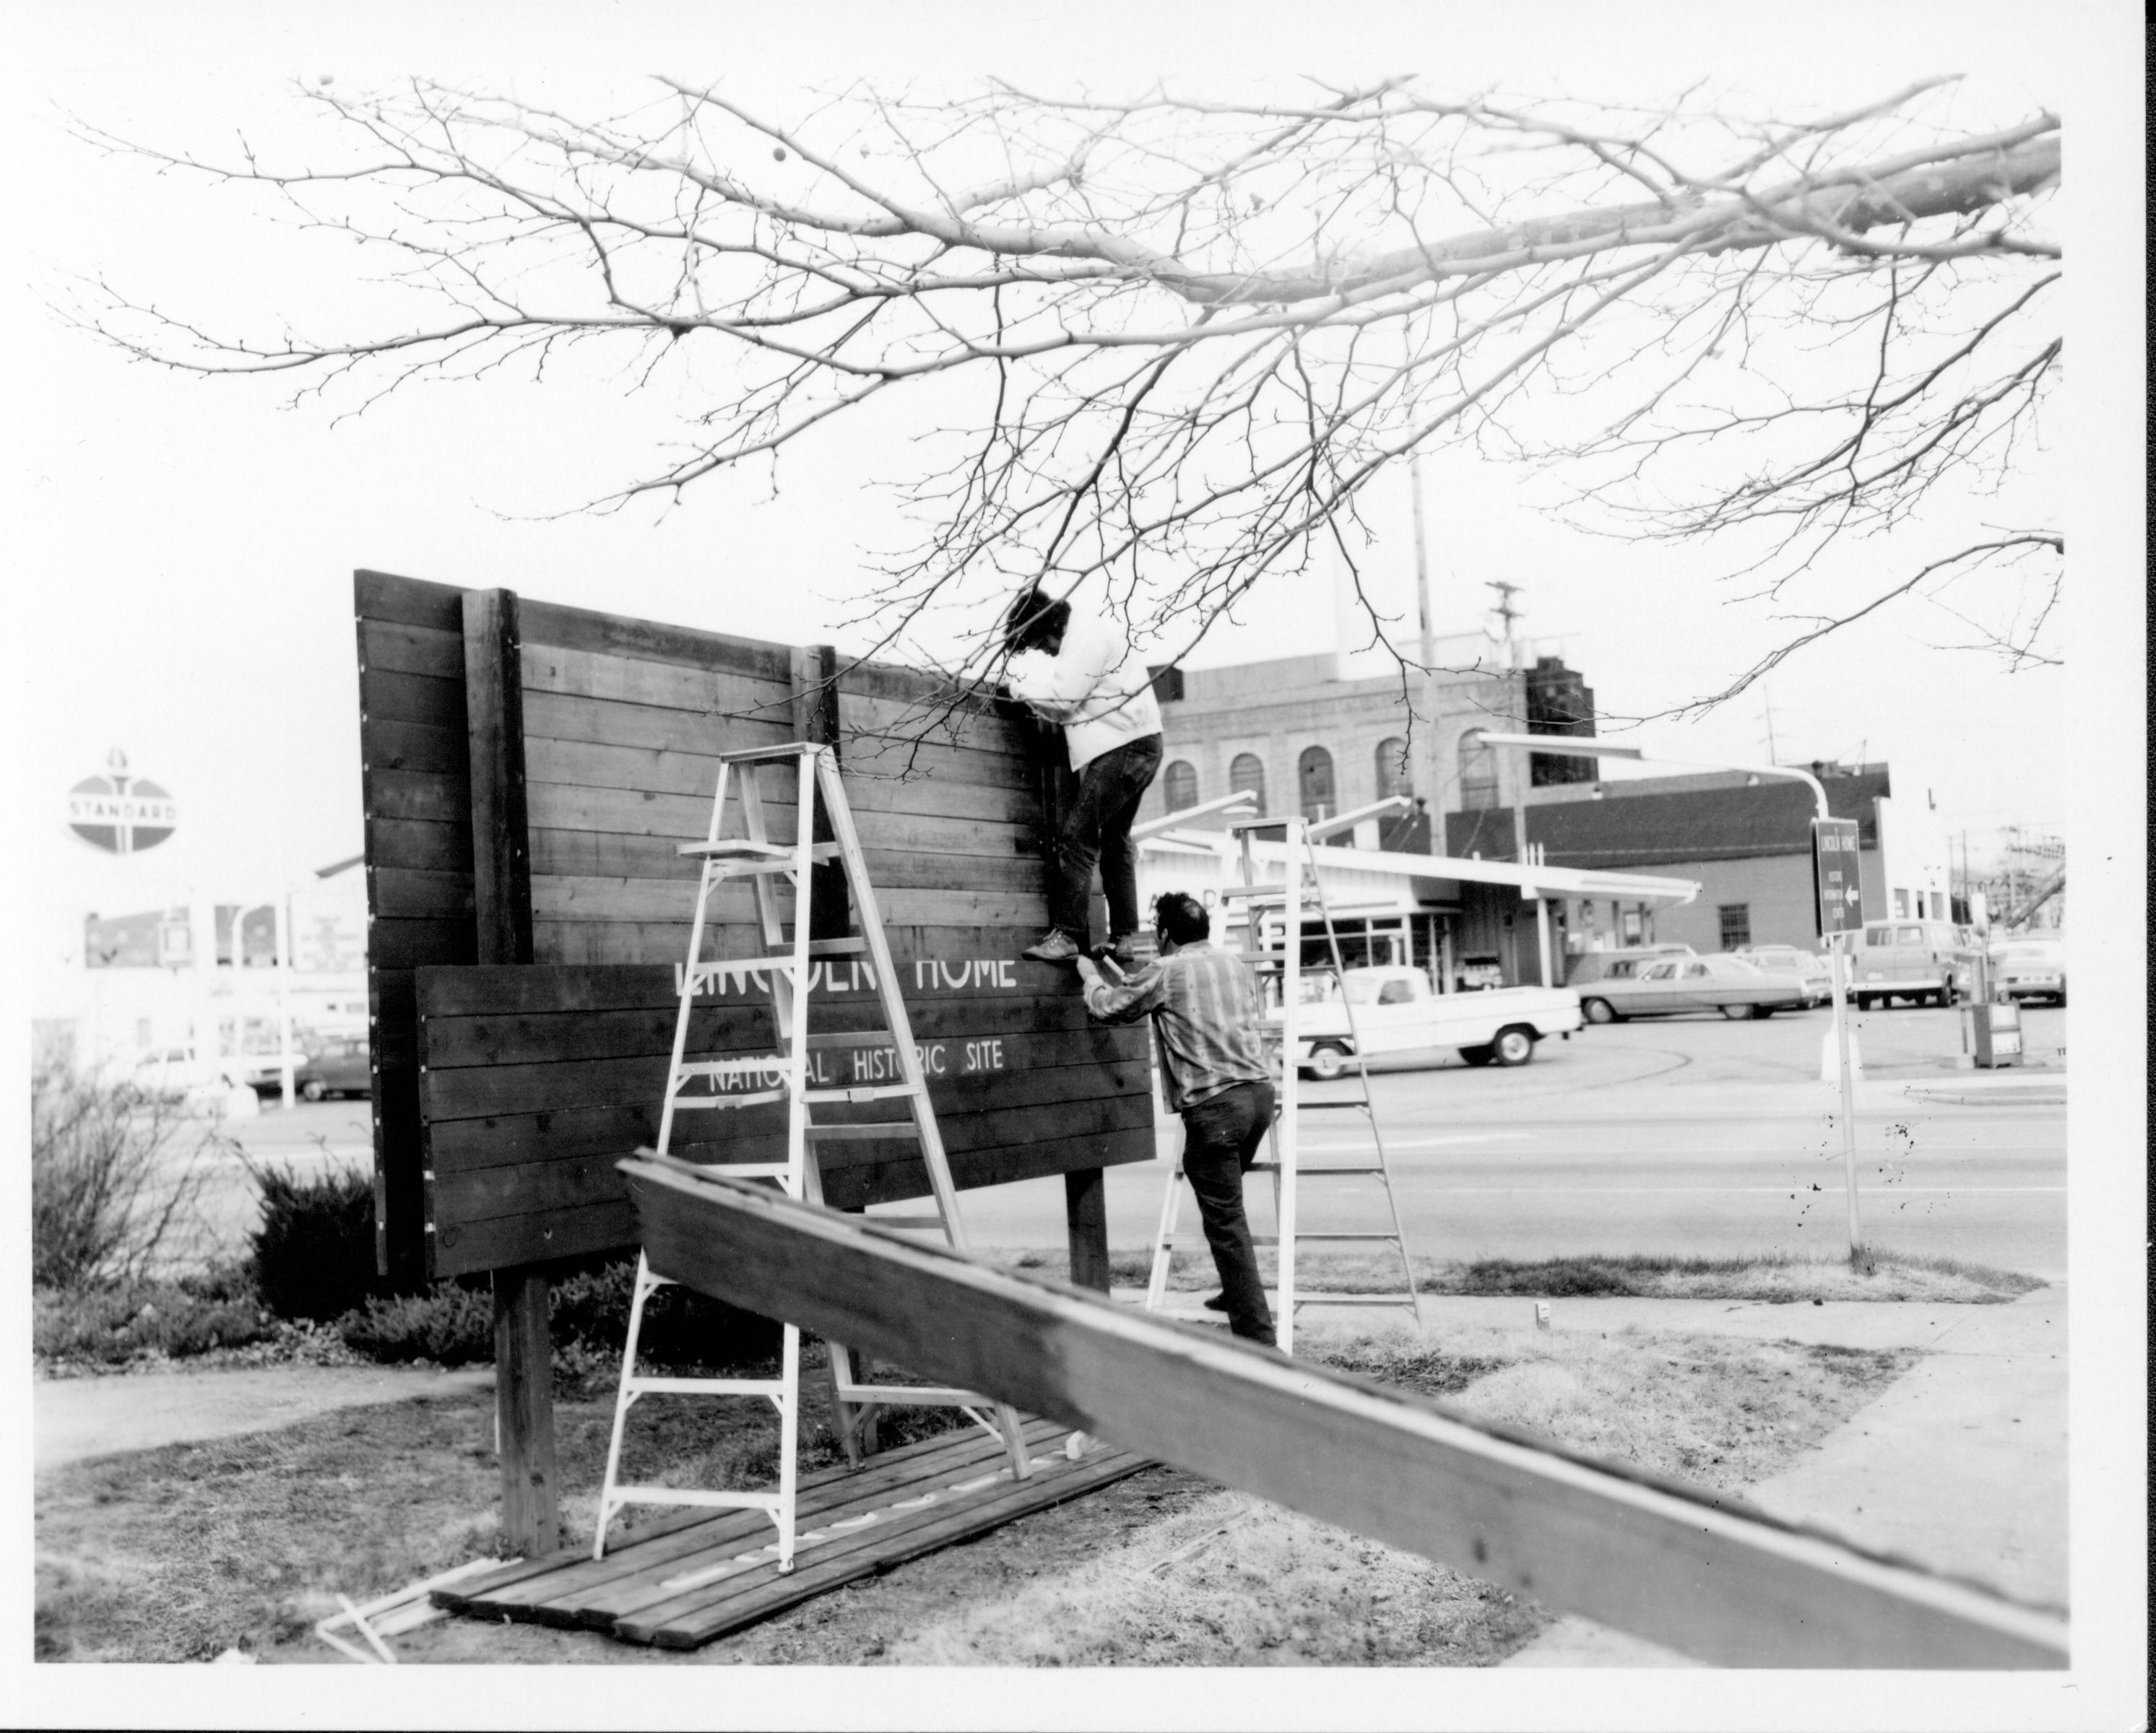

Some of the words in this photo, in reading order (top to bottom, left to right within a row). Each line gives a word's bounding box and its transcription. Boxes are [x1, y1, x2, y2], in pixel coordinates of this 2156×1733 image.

[71, 801, 176, 820] STANDARD
[1820, 835, 1840, 851] LINCOLN
[1841, 835, 1855, 851] HOME
[675, 961, 878, 996] LINLN
[709, 1051, 830, 1093] NATIOAL
[854, 1044, 945, 1081] HISTRIC
[966, 1040, 1003, 1071] SITE
